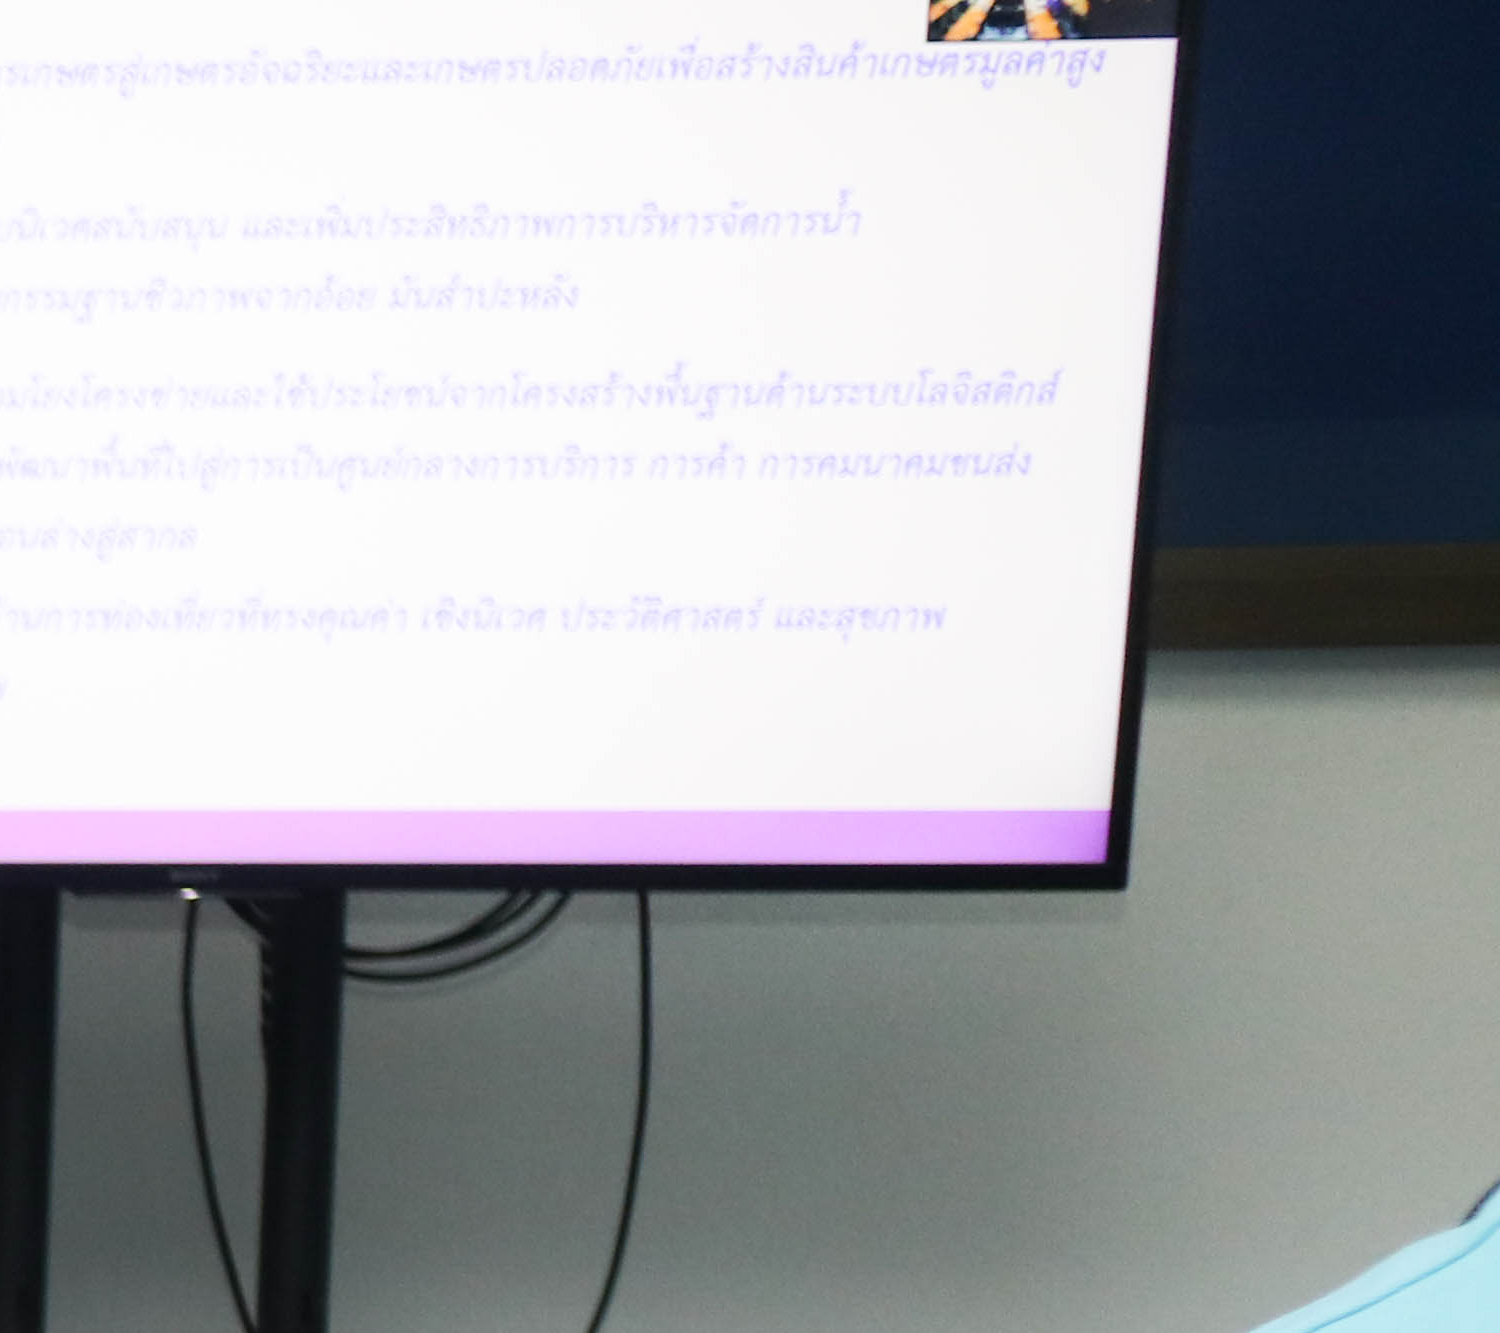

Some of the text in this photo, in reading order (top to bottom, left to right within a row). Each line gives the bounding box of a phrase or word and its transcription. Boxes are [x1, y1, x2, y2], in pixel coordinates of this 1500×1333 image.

[647, 440, 746, 480] การค้า
[758, 442, 1032, 480] การคมนาคมขนส่ง
[420, 593, 547, 632] เชิงนิเวศ
[558, 593, 767, 632] ประวัติศาสตร์
[773, 600, 946, 646] และสุขภาพ
